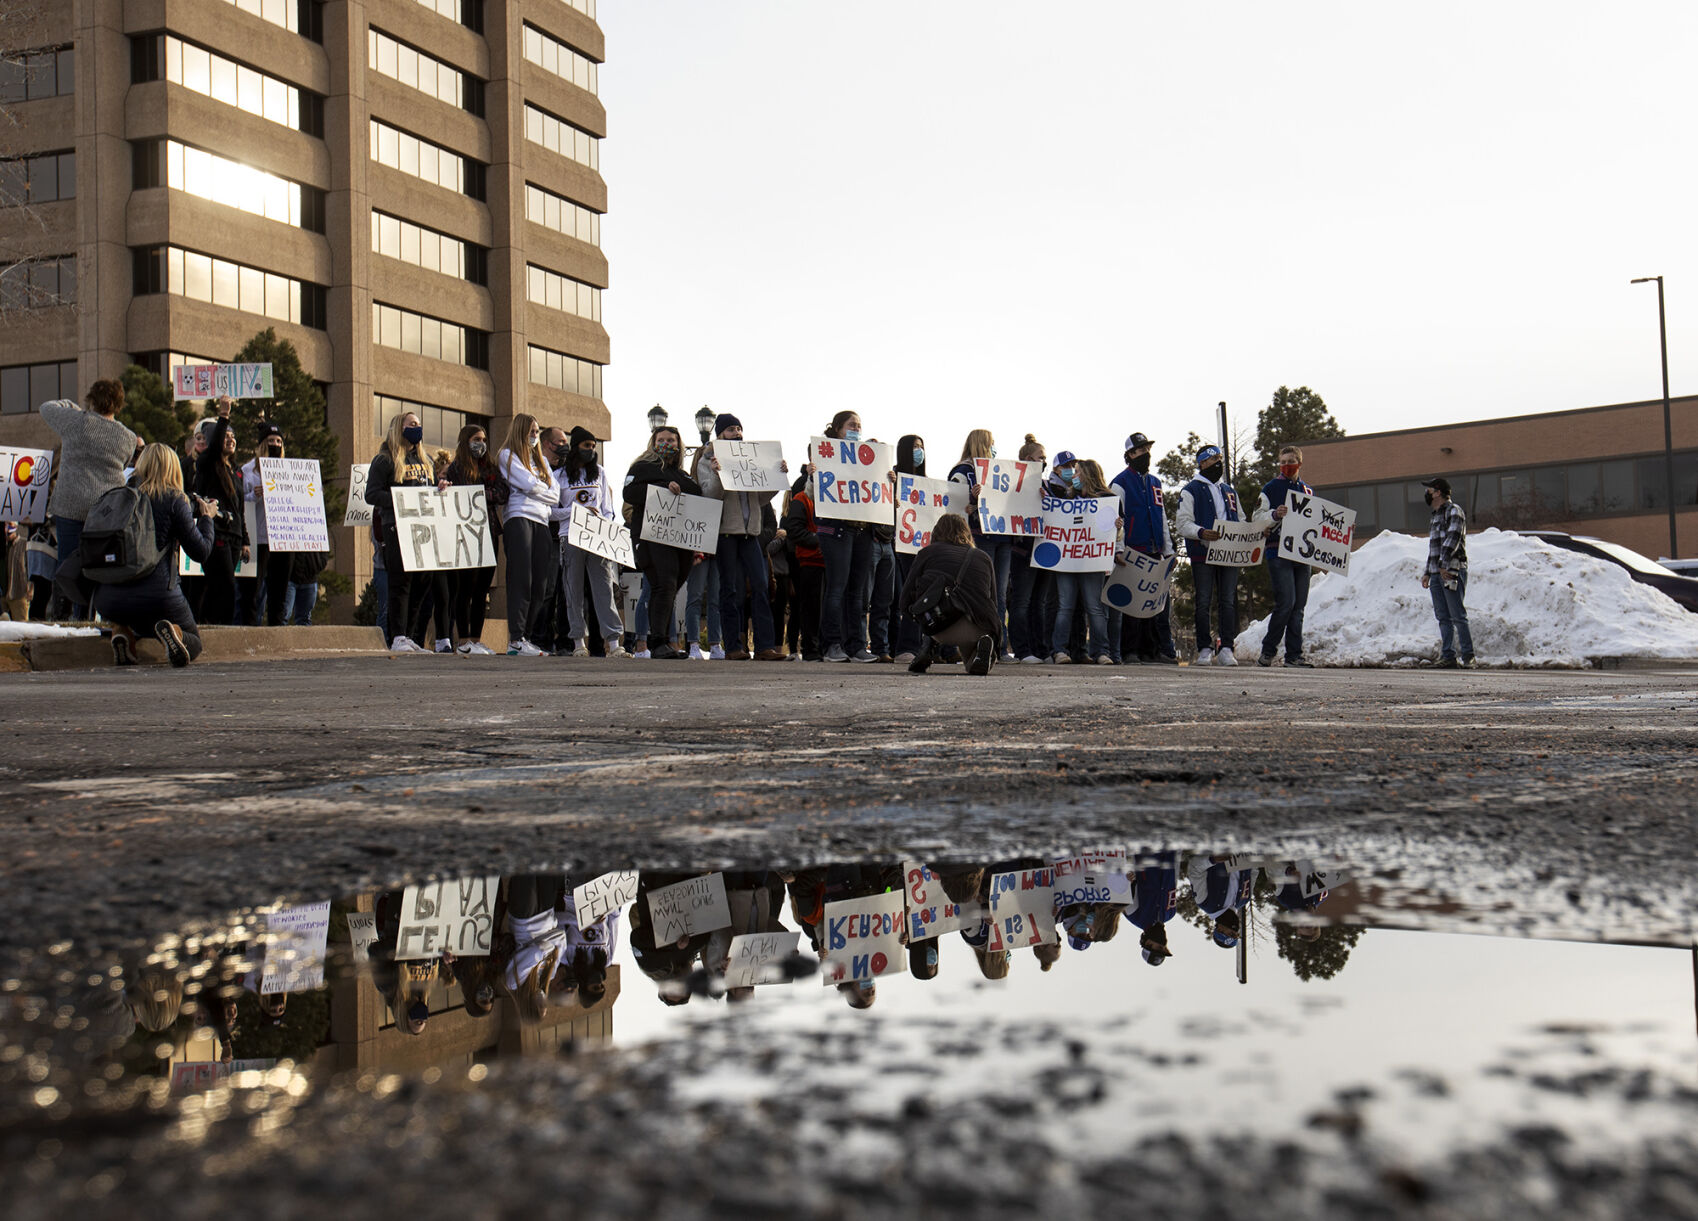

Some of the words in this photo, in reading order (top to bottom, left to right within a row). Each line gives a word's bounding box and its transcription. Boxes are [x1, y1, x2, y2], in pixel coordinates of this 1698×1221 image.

[176, 365, 218, 397] LET
[216, 374, 228, 392] US
[729, 442, 760, 457] LET
[262, 459, 284, 468] WHAT
[289, 460, 303, 470] YOU
[739, 459, 757, 471] US
[976, 459, 989, 485] 7
[992, 465, 1010, 493] is
[1015, 462, 1028, 492] 7
[293, 472, 315, 482] AWAY
[731, 470, 768, 487] PLAY!
[818, 471, 893, 504] REASON
[395, 490, 447, 519] LET
[454, 490, 487, 526] US
[656, 490, 686, 515] WE
[1042, 497, 1098, 514] SPORTS
[1291, 493, 1313, 518] We
[646, 510, 676, 527] WANT
[684, 519, 707, 533] OUR
[979, 498, 1006, 533] too
[573, 506, 607, 535] LET
[608, 524, 630, 552] US
[650, 525, 702, 548] SEASON!!!
[900, 509, 932, 548] Sea
[1322, 524, 1351, 546] need
[410, 523, 485, 568] PLAY
[1062, 542, 1115, 559] HEALTH
[1283, 536, 1294, 553] a
[1125, 550, 1158, 573] LET
[1208, 550, 1251, 564] BUSINESS
[1137, 579, 1159, 594] US
